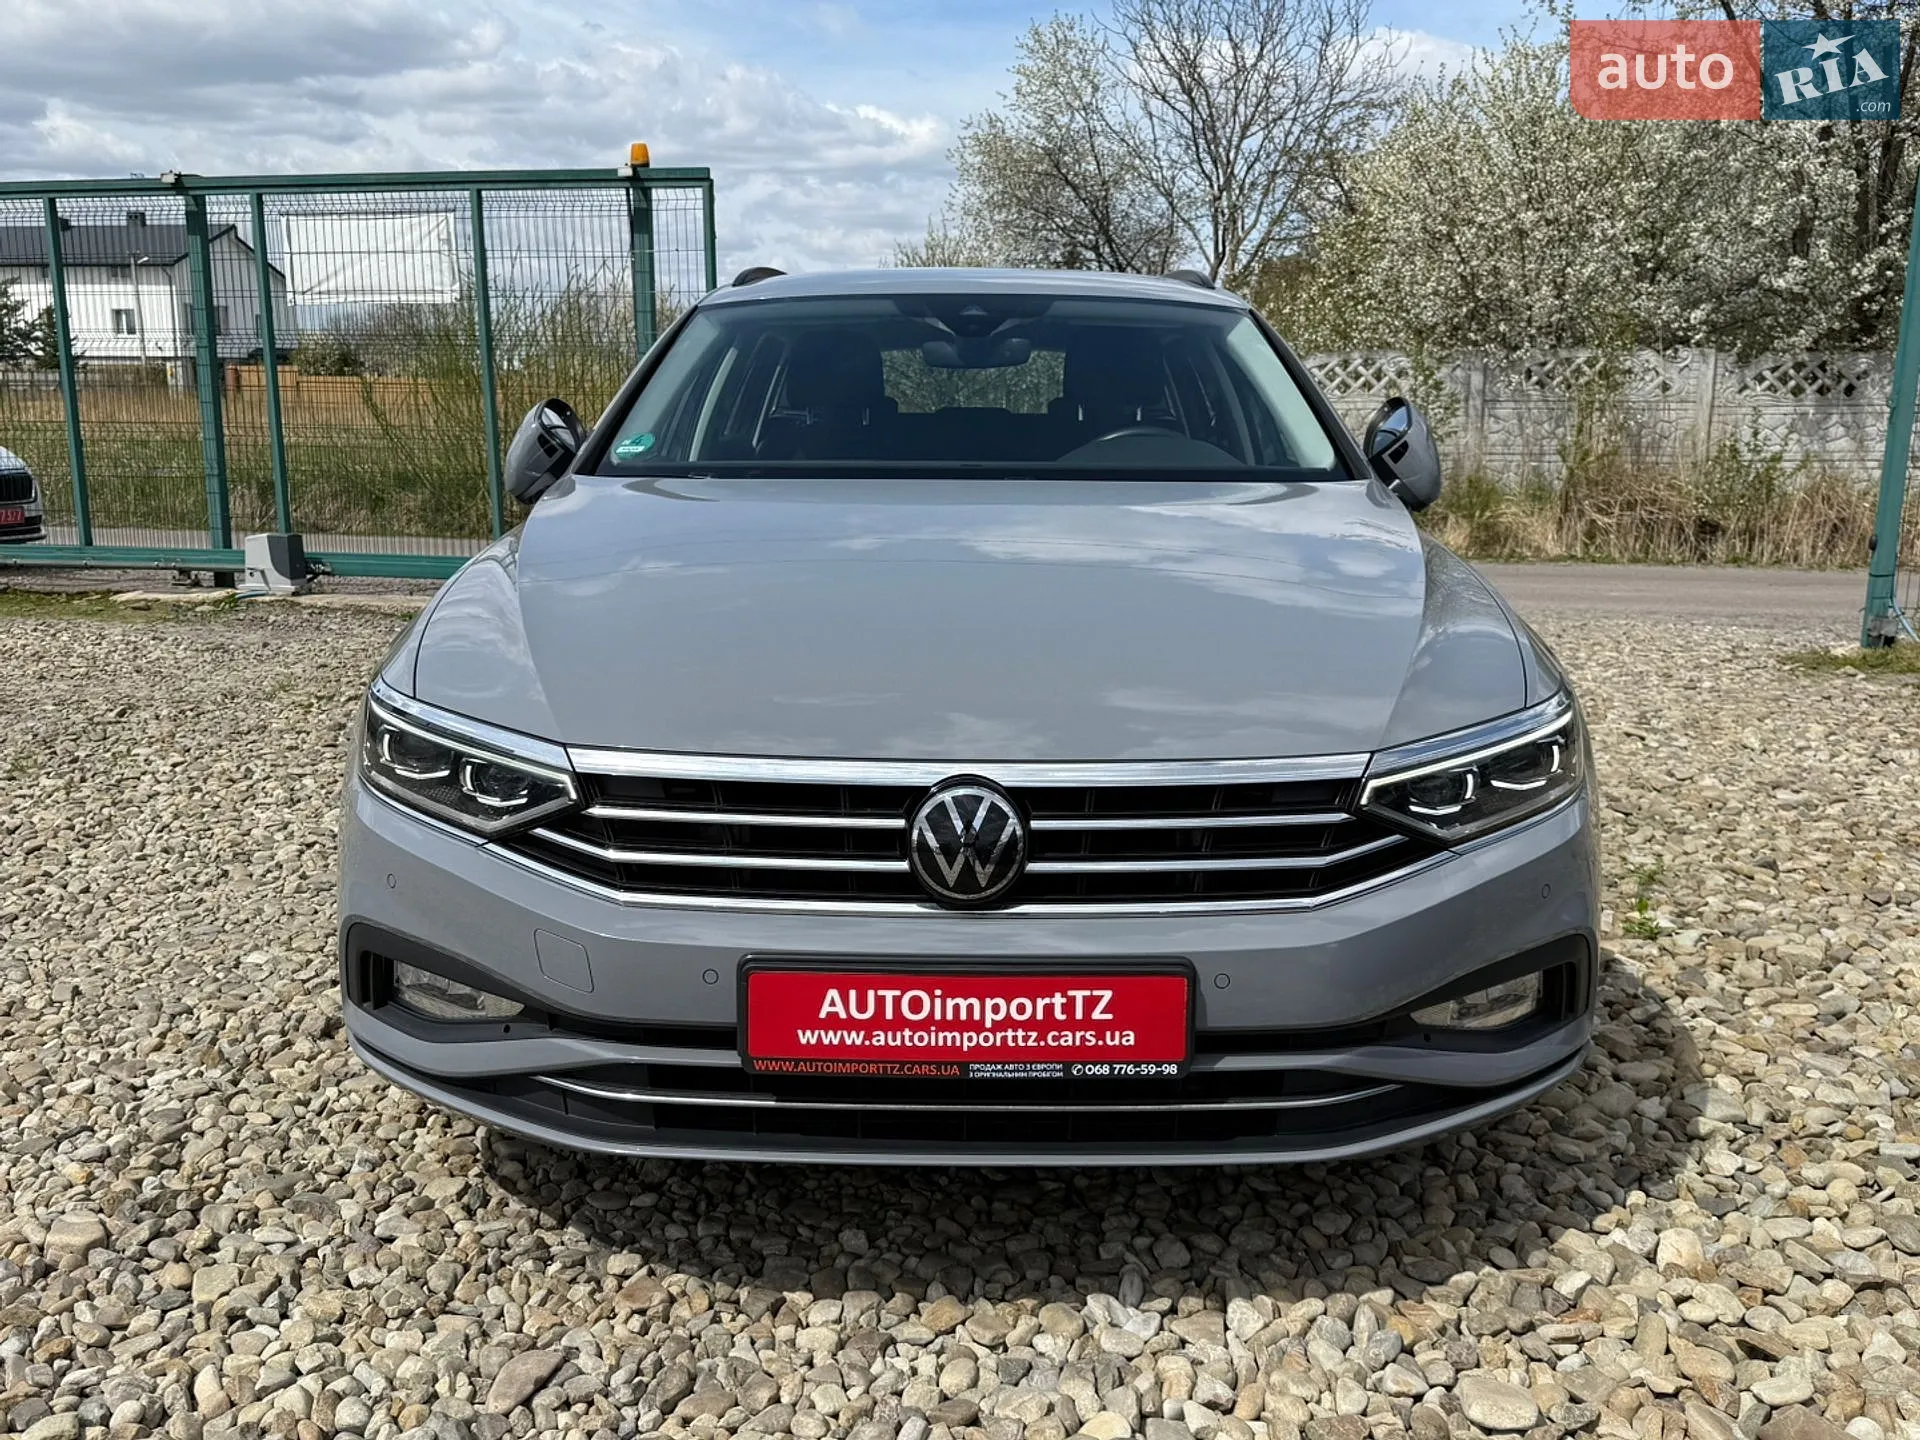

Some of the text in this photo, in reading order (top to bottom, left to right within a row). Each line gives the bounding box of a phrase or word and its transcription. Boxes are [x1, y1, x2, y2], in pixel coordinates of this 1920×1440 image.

[818, 988, 1114, 1028] AUTOimportTZ
[797, 1026, 1135, 1051] www.autoimporttz.cars.ua
[753, 1059, 960, 1076] WWW.AUTOIMPORTTZ.CARS.UA
[1085, 1063, 1178, 1075] 068 776-59-98
